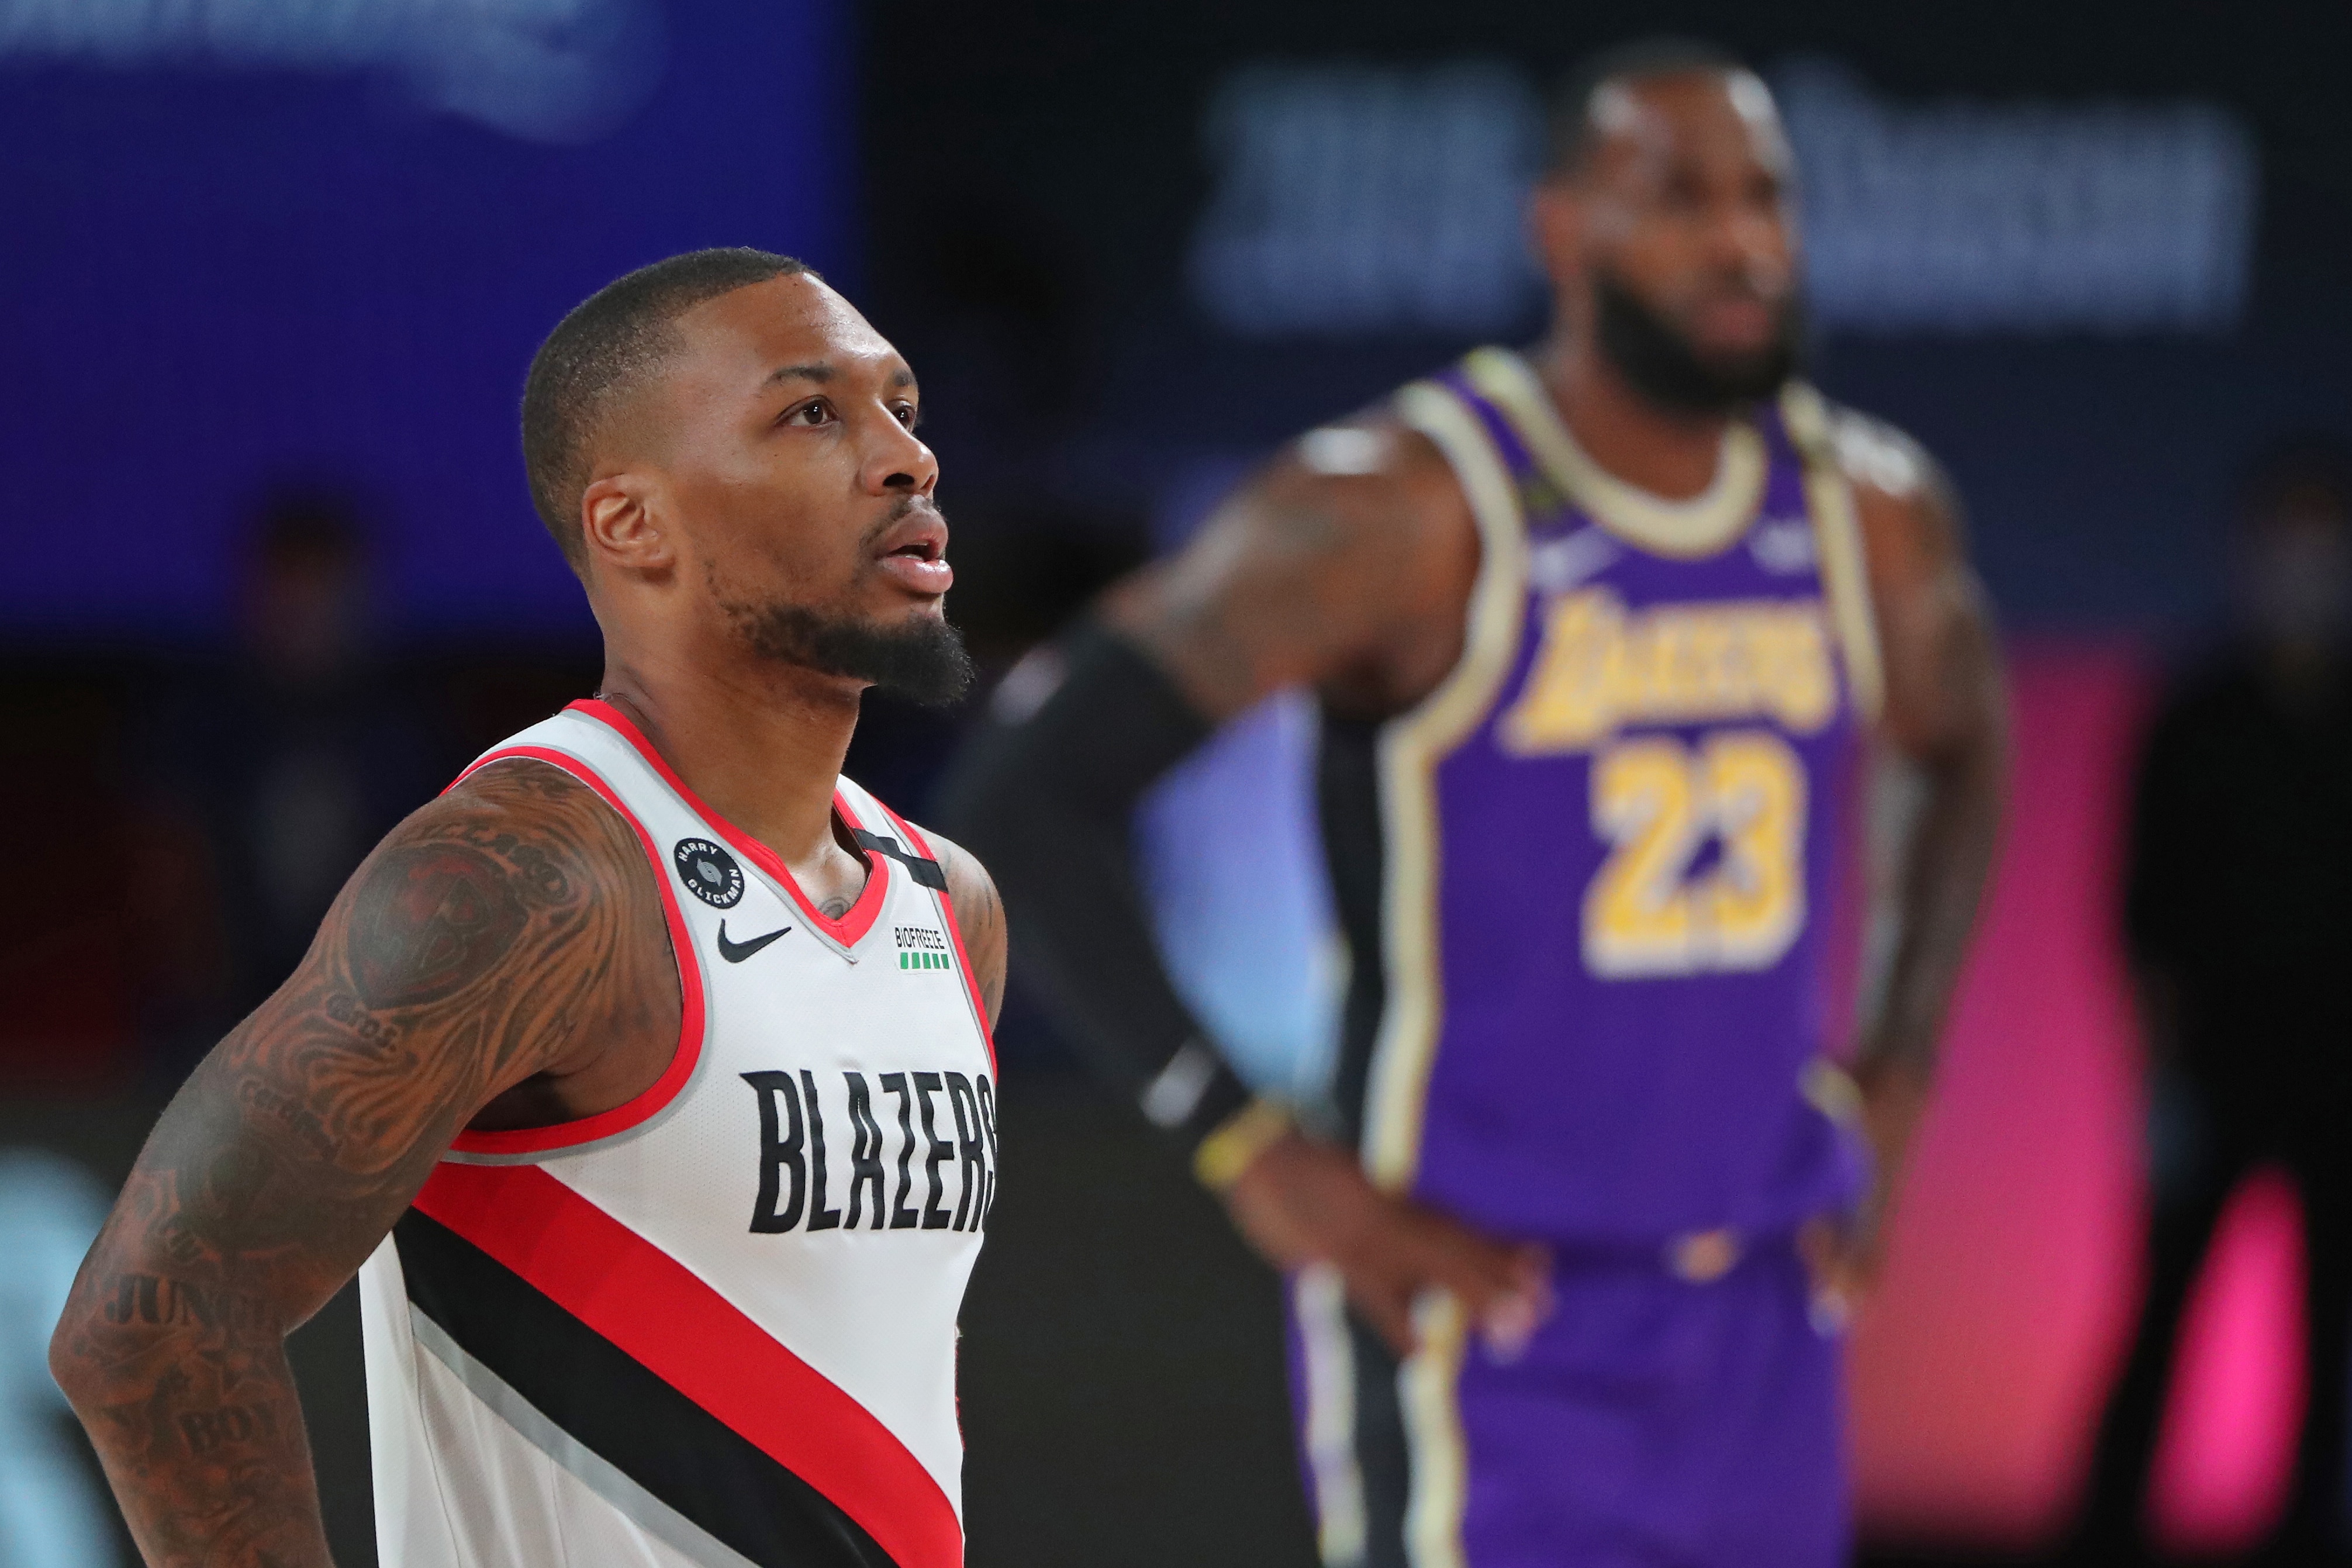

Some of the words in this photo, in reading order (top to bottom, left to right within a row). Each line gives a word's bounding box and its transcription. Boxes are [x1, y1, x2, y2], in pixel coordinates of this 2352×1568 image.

[678, 842, 718, 862] HARRY
[688, 869, 742, 904] GLICKMAN
[1582, 734, 1809, 981] 23
[739, 1069, 997, 1234] BLAZERS
